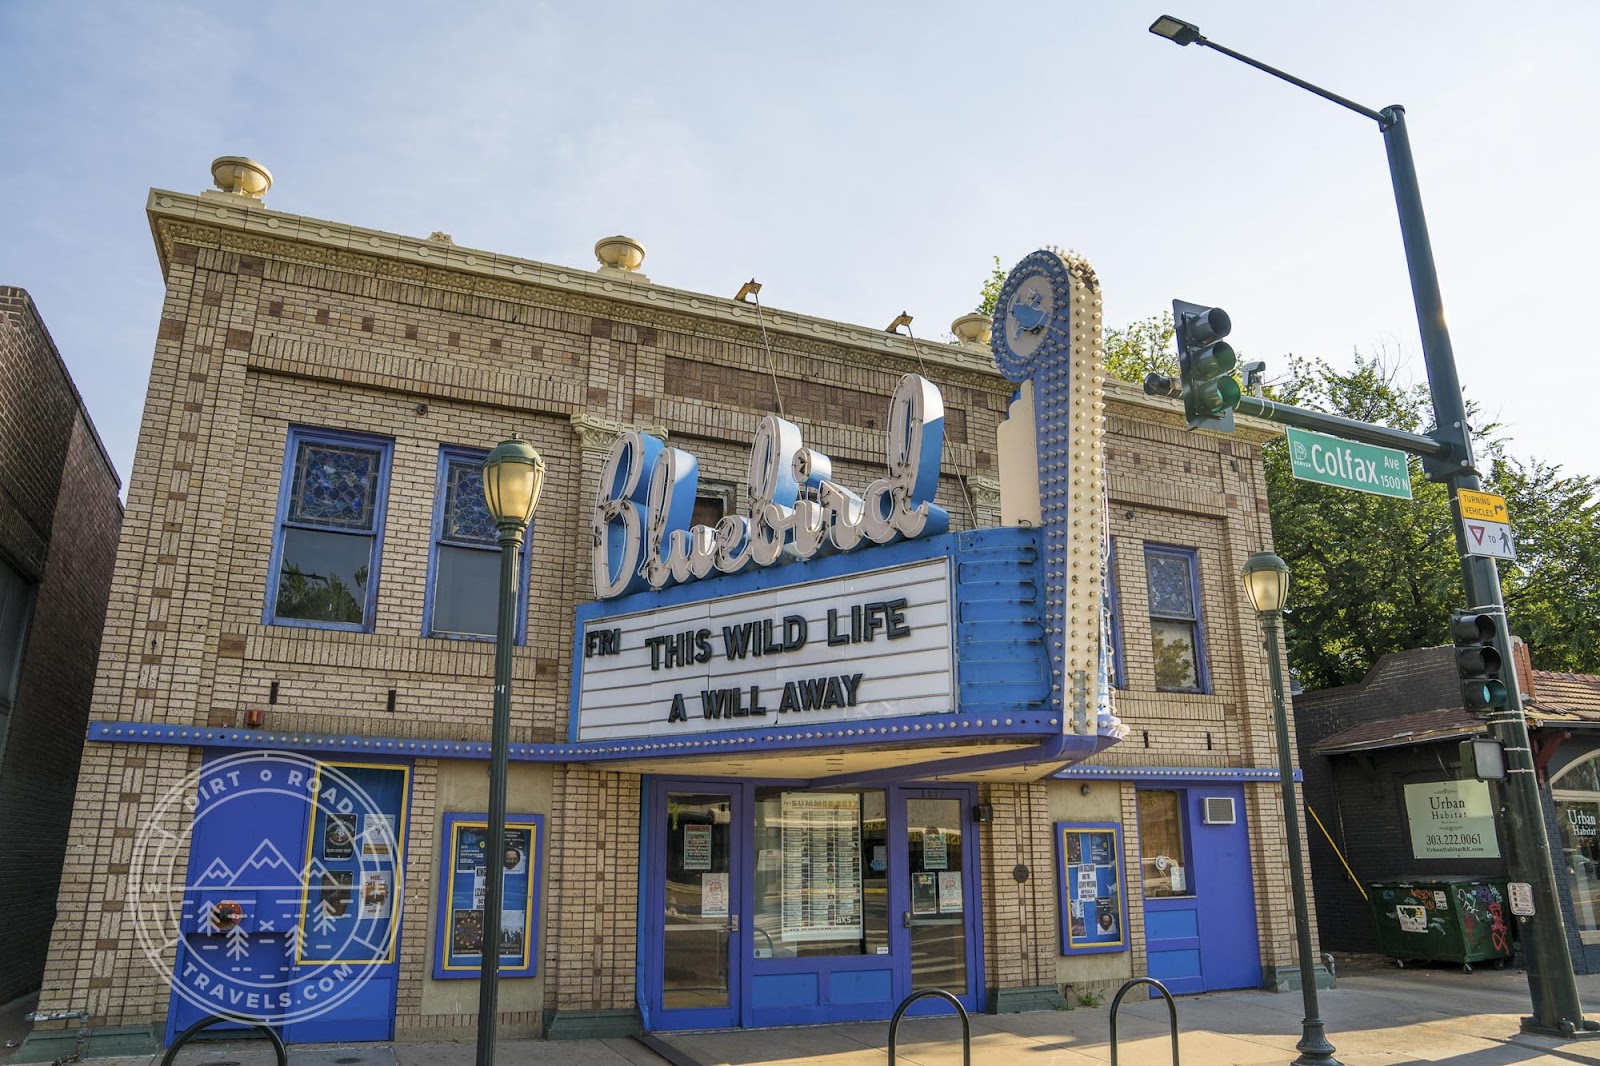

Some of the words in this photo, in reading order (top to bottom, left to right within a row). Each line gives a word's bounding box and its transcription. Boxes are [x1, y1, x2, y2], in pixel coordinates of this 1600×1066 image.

[1294, 460, 1311, 468] DENVER
[1311, 443, 1379, 485] Colfax
[1384, 456, 1400, 470] Ave
[592, 373, 948, 600] Bluebird
[1380, 475, 1401, 490] 1500
[1402, 478, 1409, 491] N
[1463, 494, 1491, 506] TURNING
[1464, 506, 1494, 517] VEHICLES
[1488, 535, 1497, 544] TO
[586, 627, 621, 659] FRI
[645, 628, 712, 671] THIS
[722, 614, 808, 661] WILD
[827, 597, 912, 647] LIFE
[667, 693, 687, 723] A
[700, 685, 766, 720] WILL
[778, 673, 863, 714] AWAY
[1429, 796, 1466, 810] Urban
[1431, 811, 1467, 820] Habitat
[1566, 809, 1597, 825] Urban
[1572, 825, 1597, 836] Habitat
[1426, 833, 1482, 846] 303.222.0061
